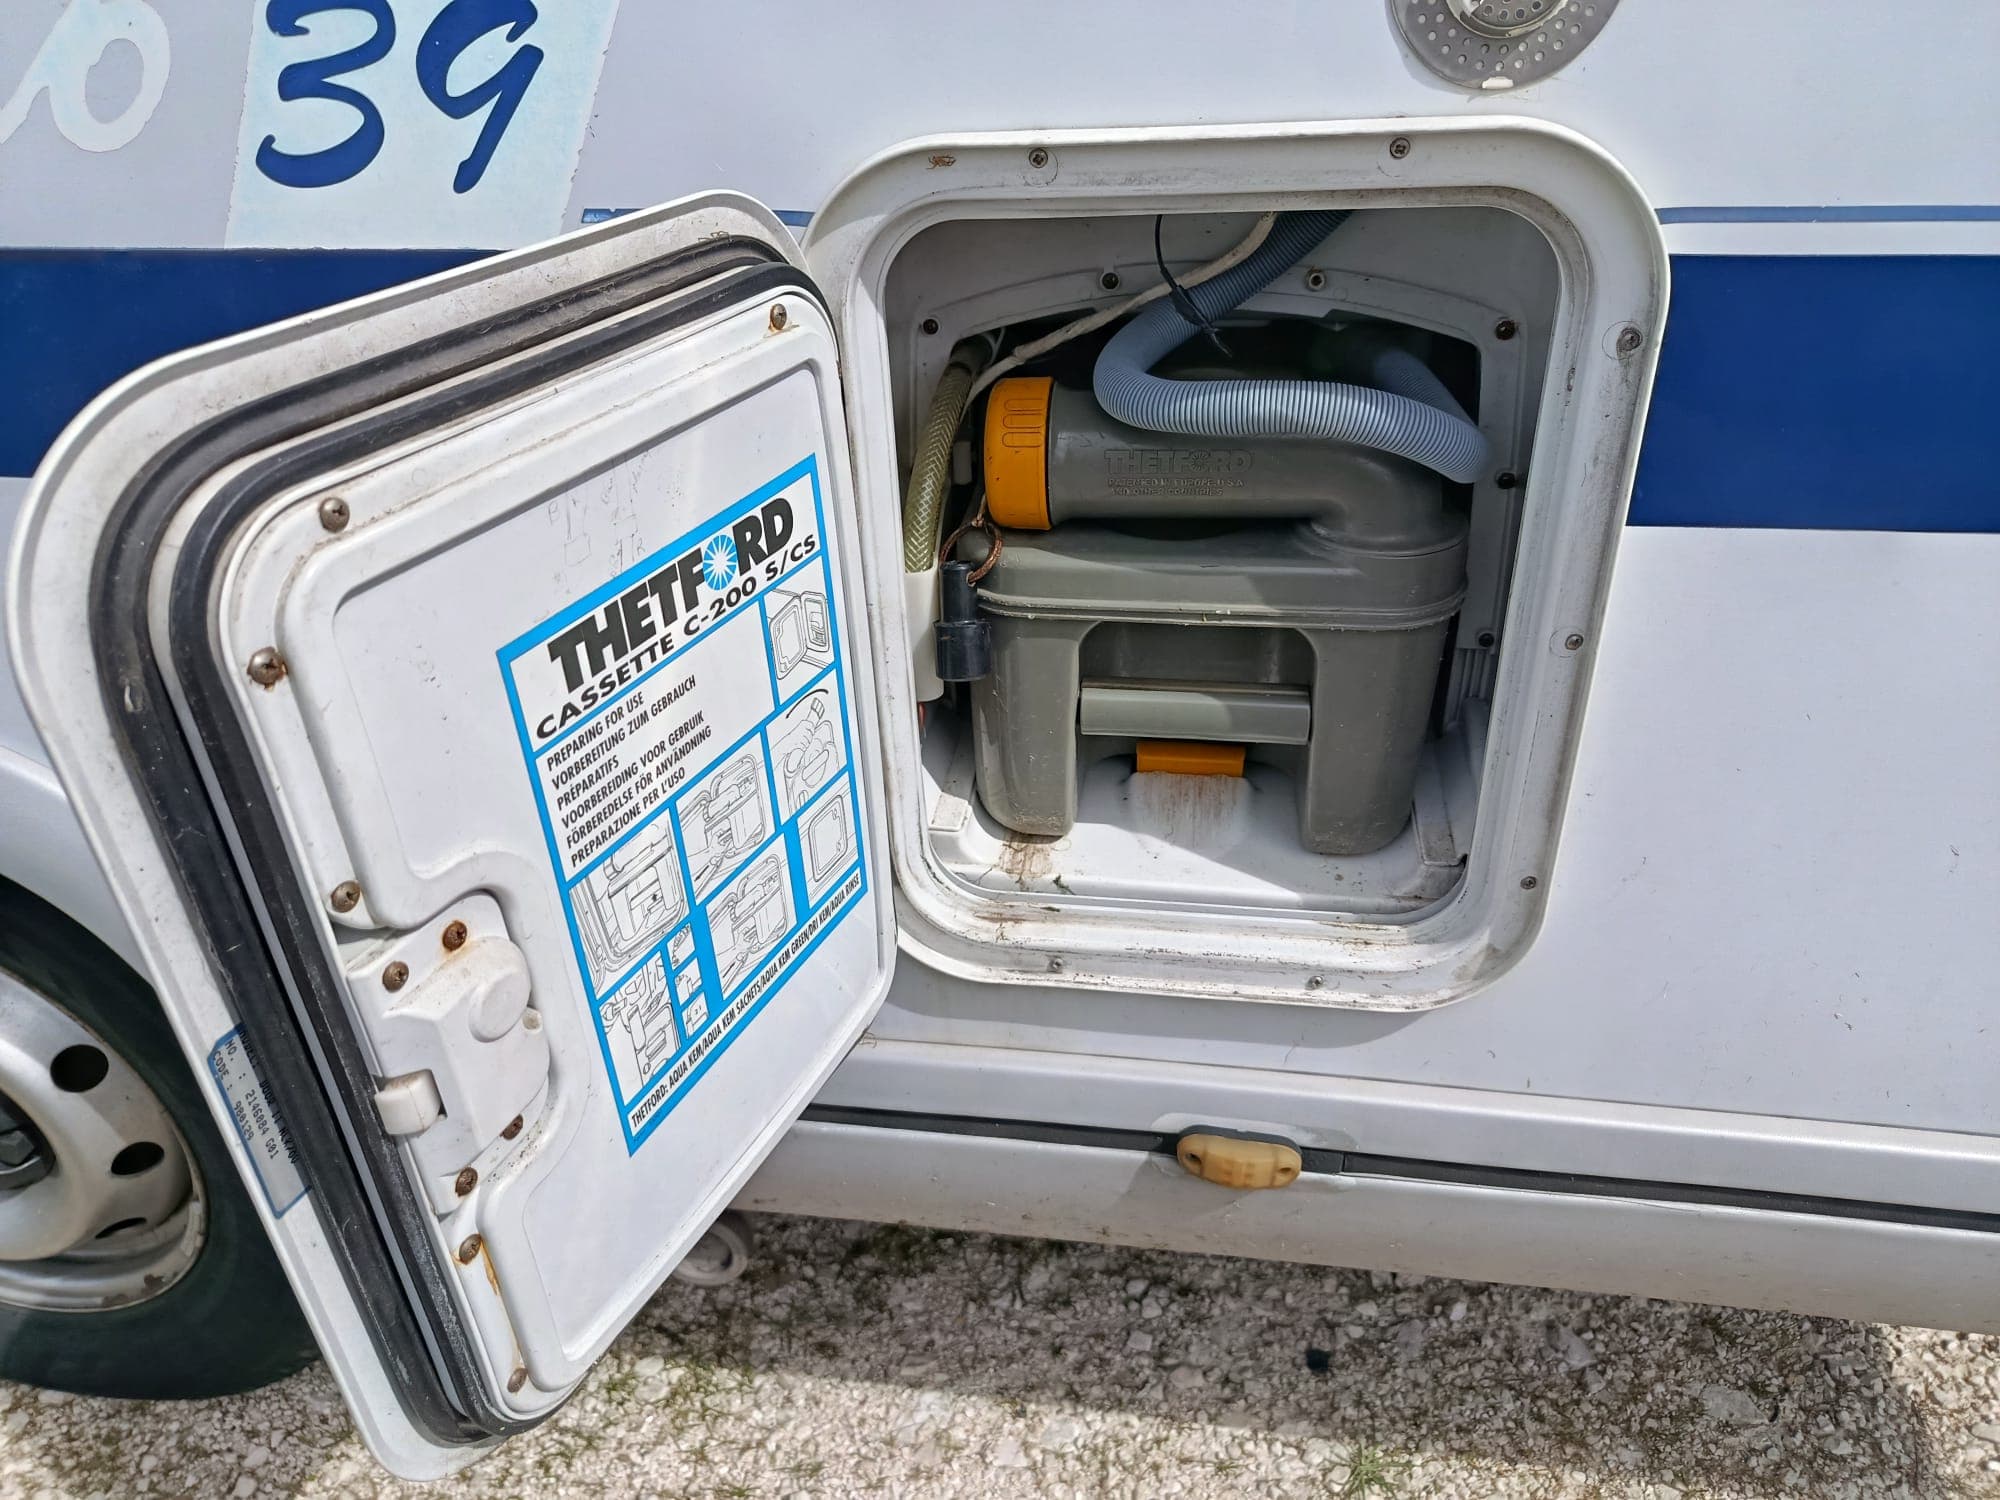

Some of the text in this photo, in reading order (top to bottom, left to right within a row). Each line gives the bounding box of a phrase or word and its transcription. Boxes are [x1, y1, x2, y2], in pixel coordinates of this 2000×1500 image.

[255, 0, 545, 194] 39
[1103, 449, 1252, 474] THETFORD
[536, 534, 816, 740] CASSETTE C-200 S/CS
[547, 497, 794, 694] THETFORD
[546, 691, 645, 772] PREPARING FOR USE
[551, 675, 697, 790] VORBEREITUNG ZUM GEBRAUCH
[556, 754, 620, 812] PRÉPARATIFS
[561, 710, 705, 830] VOORBEREIDING VOOR GEBRUIK
[566, 725, 712, 849] FÖRBEREDELSE FÖR ANVÄNDNING
[570, 766, 686, 868] PREPARAZIONE PER L'USO
[631, 873, 861, 1129] THETFORD: AQUA KEM/AQUA KEM SACHETS/AQUA KEM GREEN/DRI KEM/AQUA RINSE
[212, 1051, 230, 1081] CODE
